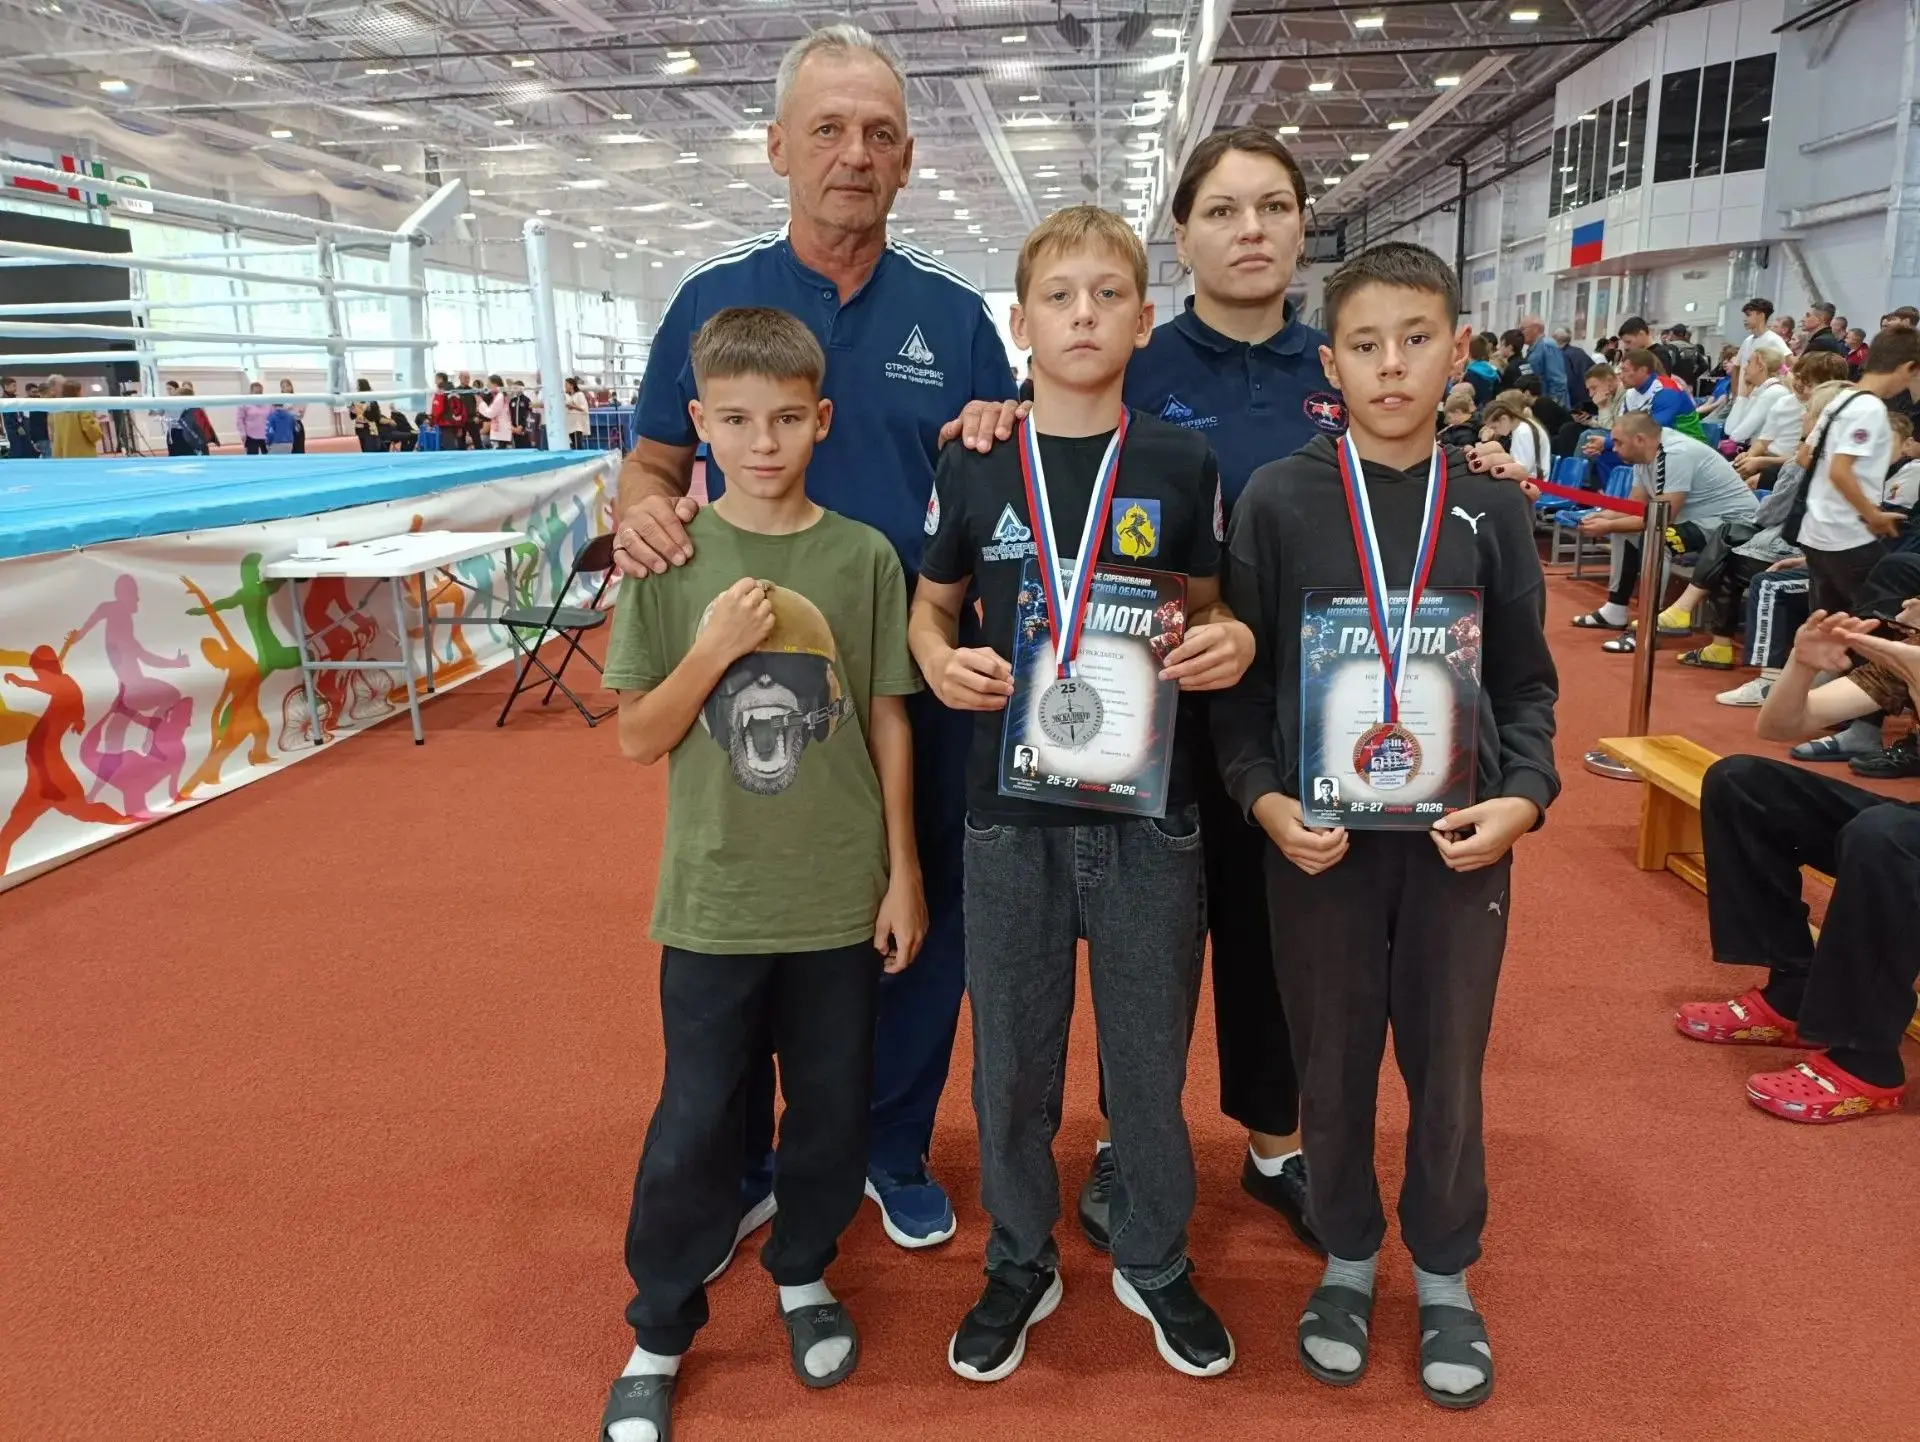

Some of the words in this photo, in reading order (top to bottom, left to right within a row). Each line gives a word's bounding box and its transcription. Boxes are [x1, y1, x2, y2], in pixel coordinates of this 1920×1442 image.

[885, 362, 944, 381] СТРОЙСЕРВИС
[1119, 587, 1157, 599] ОБЛАСТИ
[1332, 597, 1369, 605] РЕГИОНАЛ
[1084, 602, 1152, 637] АМОТА
[1060, 683, 1077, 694] 25
[1046, 774, 1079, 788] 25-27
[1108, 783, 1136, 796] 2026
[1350, 802, 1383, 812] 25-27
[1415, 802, 1443, 813] 2026
